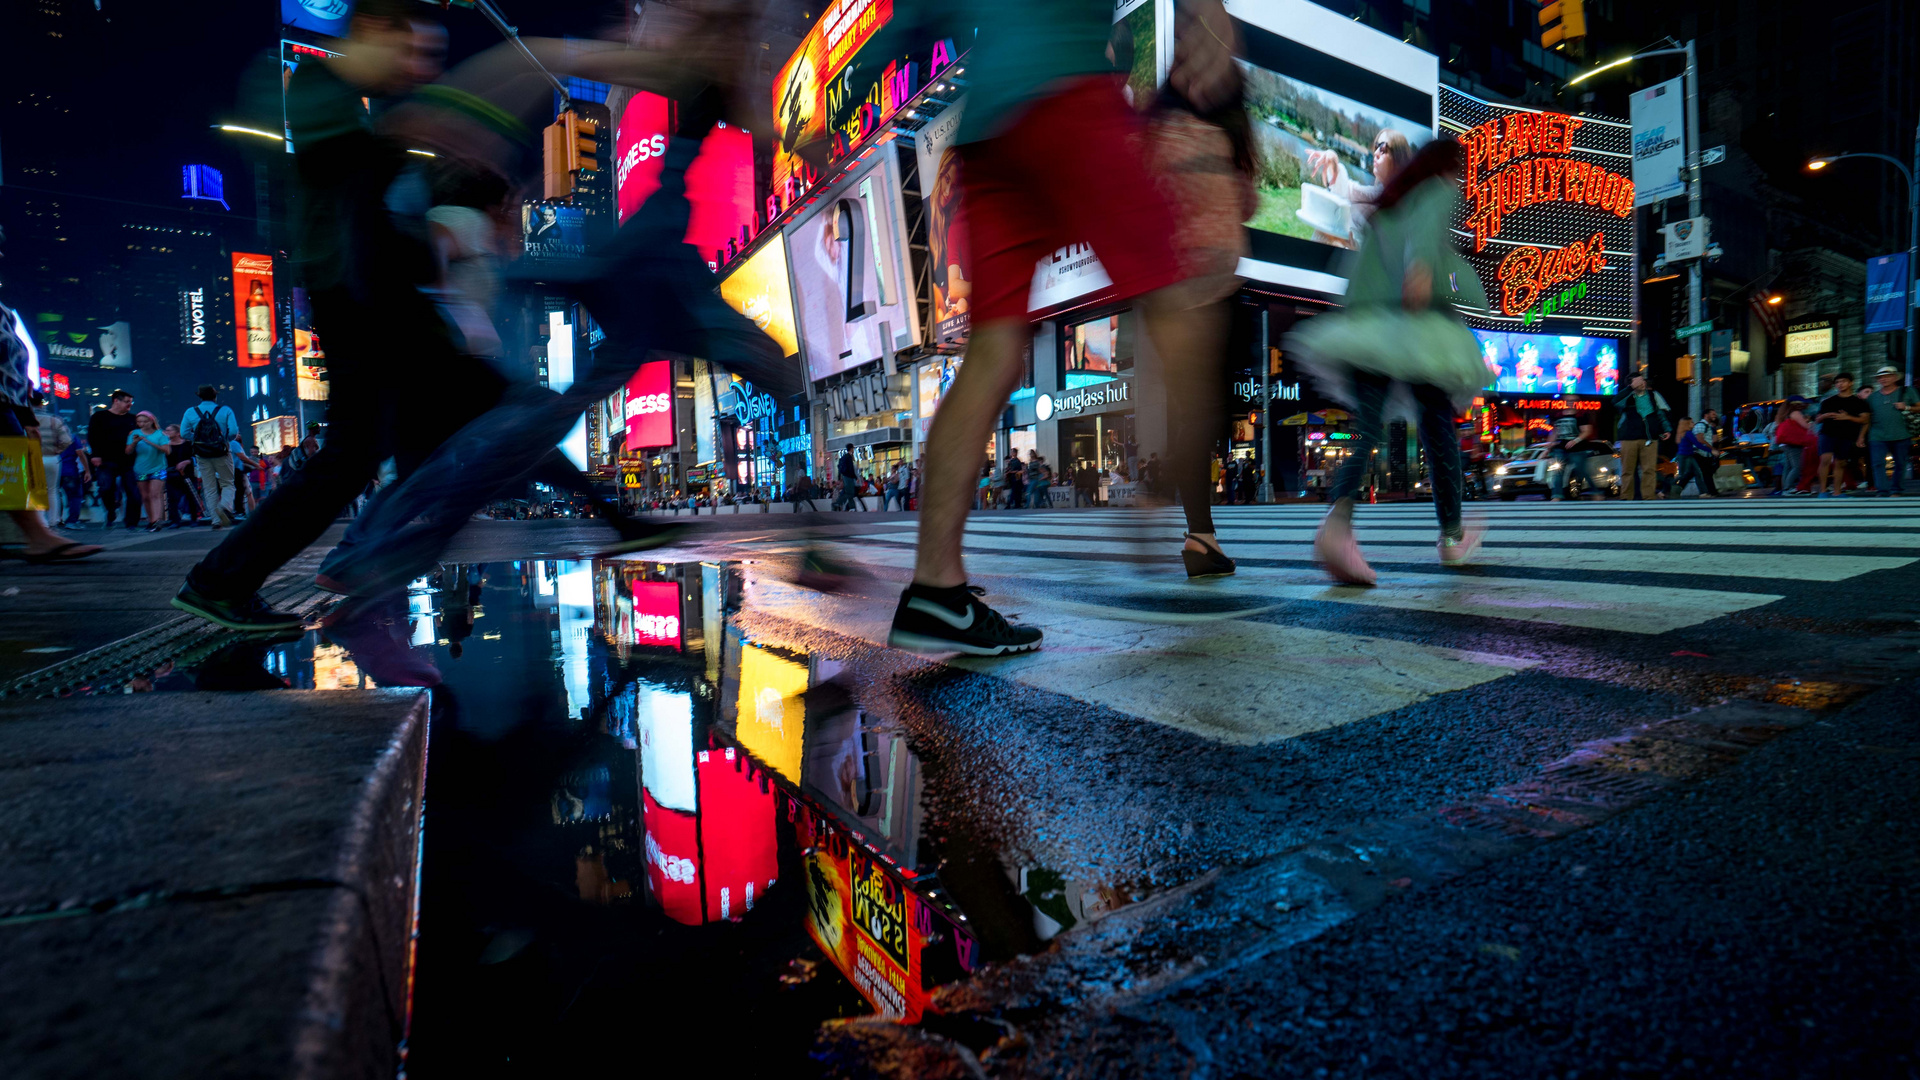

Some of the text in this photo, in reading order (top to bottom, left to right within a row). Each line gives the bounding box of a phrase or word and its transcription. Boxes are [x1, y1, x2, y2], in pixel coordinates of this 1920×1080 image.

[828, 23, 857, 72] JANUARY
[859, 2, 876, 36] 14TH
[618, 134, 666, 192] EXPRESS
[1458, 111, 1582, 200] PLANET
[1466, 158, 1636, 253] HOLLYWOOD
[525, 242, 585, 254] PHANTOM
[189, 287, 206, 345] NOVOTEL
[1542, 282, 1588, 318] BEPPO
[1677, 323, 1711, 339] Broadway
[48, 343, 95, 358] WICKED
[825, 369, 893, 424] FOREVER
[1053, 381, 1129, 415] sunglass hut
[1277, 379, 1301, 401] hut
[1518, 399, 1602, 410] PLANET HOLWOOD
